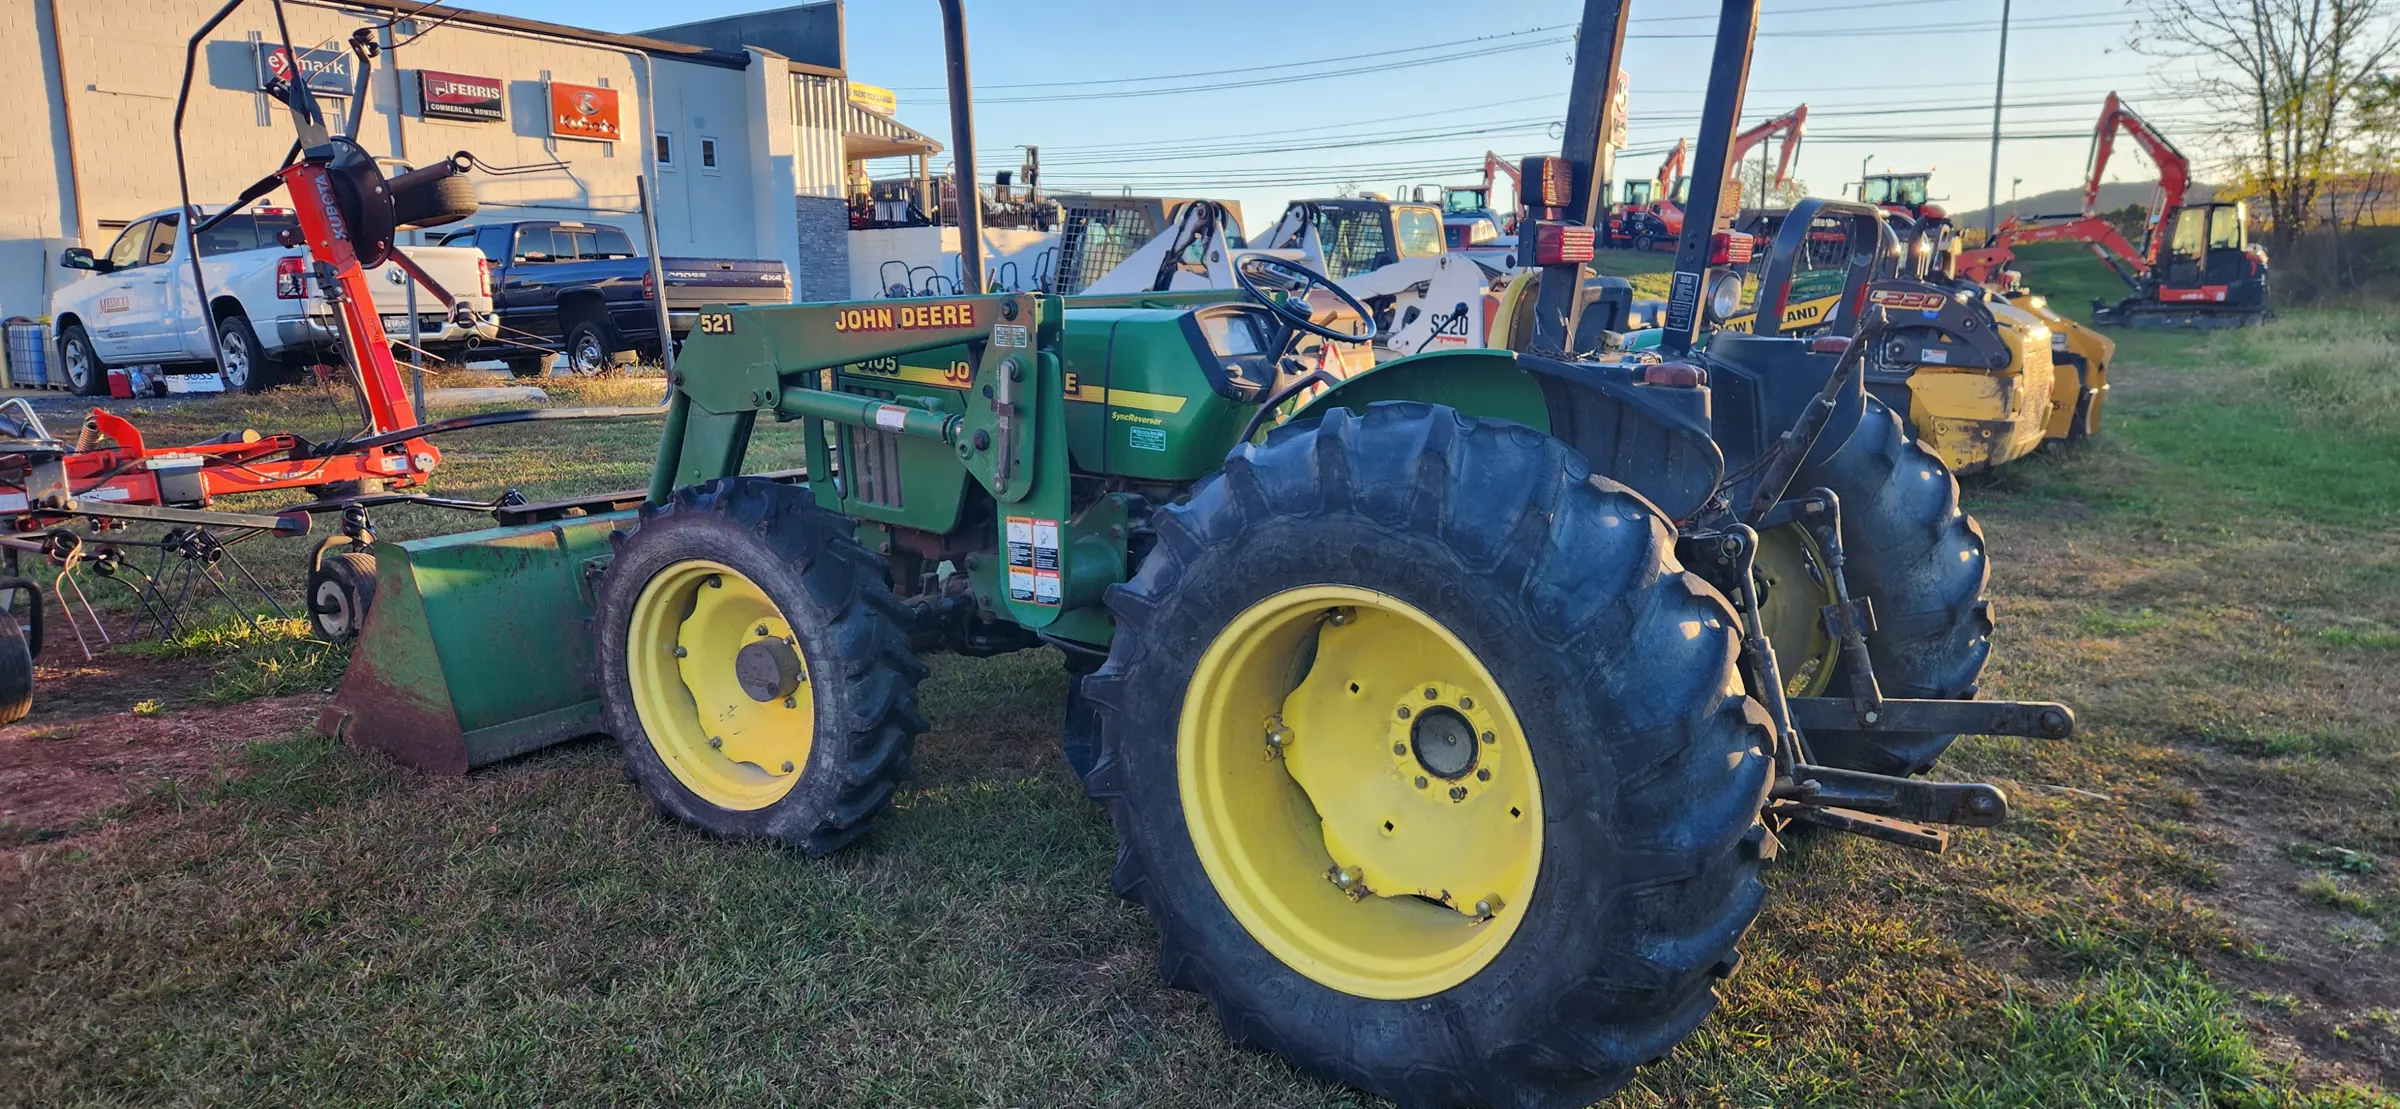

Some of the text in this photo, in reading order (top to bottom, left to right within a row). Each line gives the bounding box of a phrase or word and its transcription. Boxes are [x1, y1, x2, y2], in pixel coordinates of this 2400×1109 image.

[448, 83, 500, 99] FERRIS
[430, 103, 501, 117] COMMERCIAL MOWERS
[559, 114, 619, 134] Kubota
[315, 174, 348, 240] KUBOTA
[700, 313, 733, 333] 521
[835, 304, 973, 331] JOHN DEERE
[1430, 313, 1468, 335] S220
[944, 360, 970, 379] JO
[1111, 411, 1162, 425] SyncReverser
